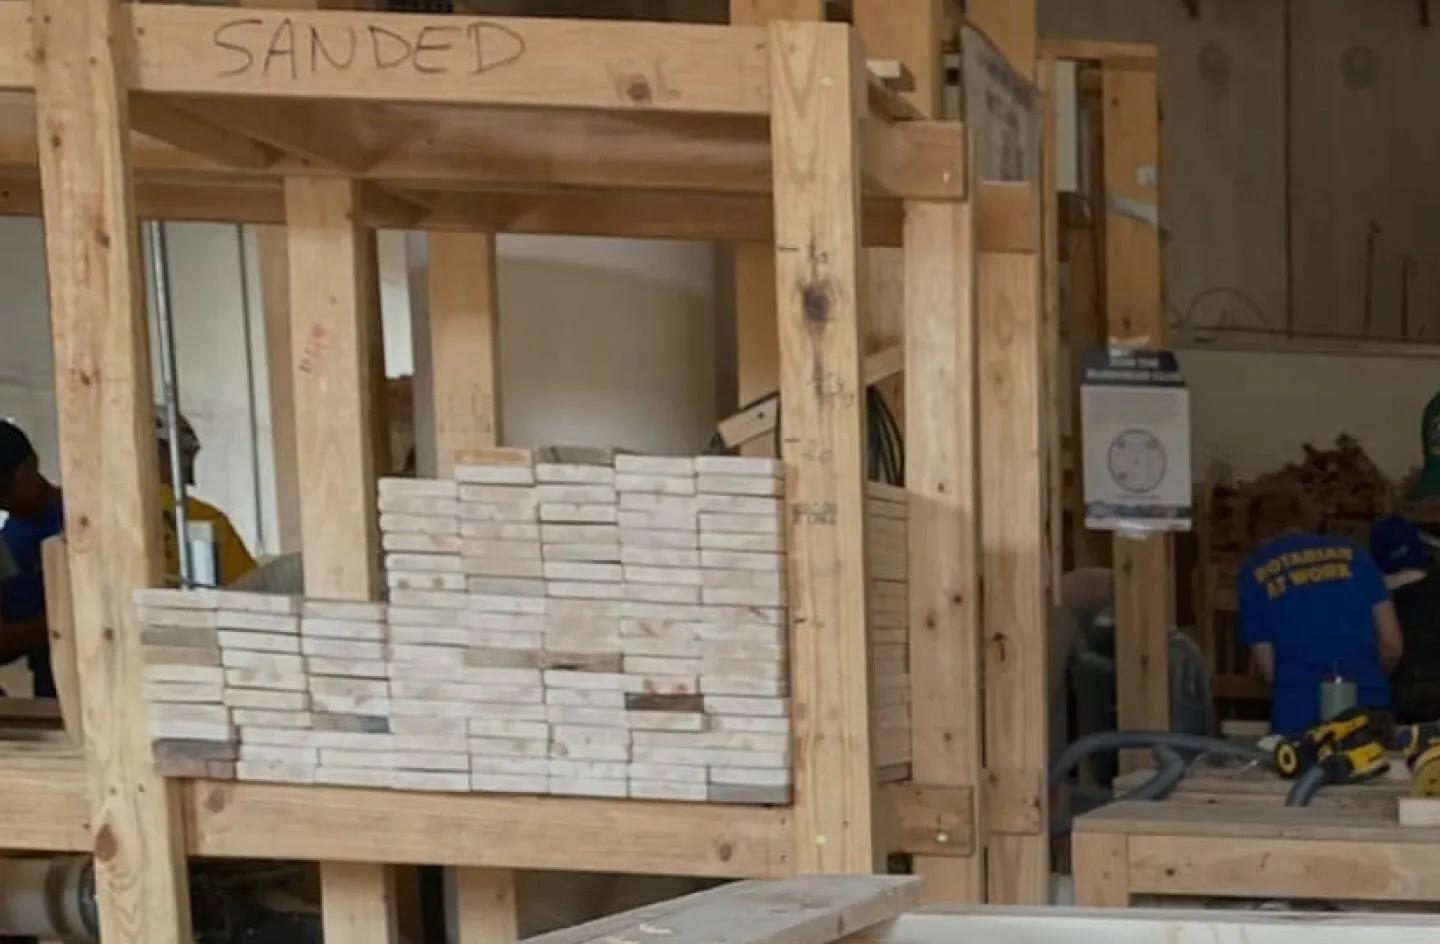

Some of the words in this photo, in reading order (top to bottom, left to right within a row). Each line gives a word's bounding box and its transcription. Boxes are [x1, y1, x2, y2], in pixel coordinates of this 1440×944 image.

[213, 17, 526, 80] SANDED
[1253, 546, 1353, 584] ROTARIAN
[1265, 575, 1288, 601] AT
[1289, 562, 1354, 587] WORK
